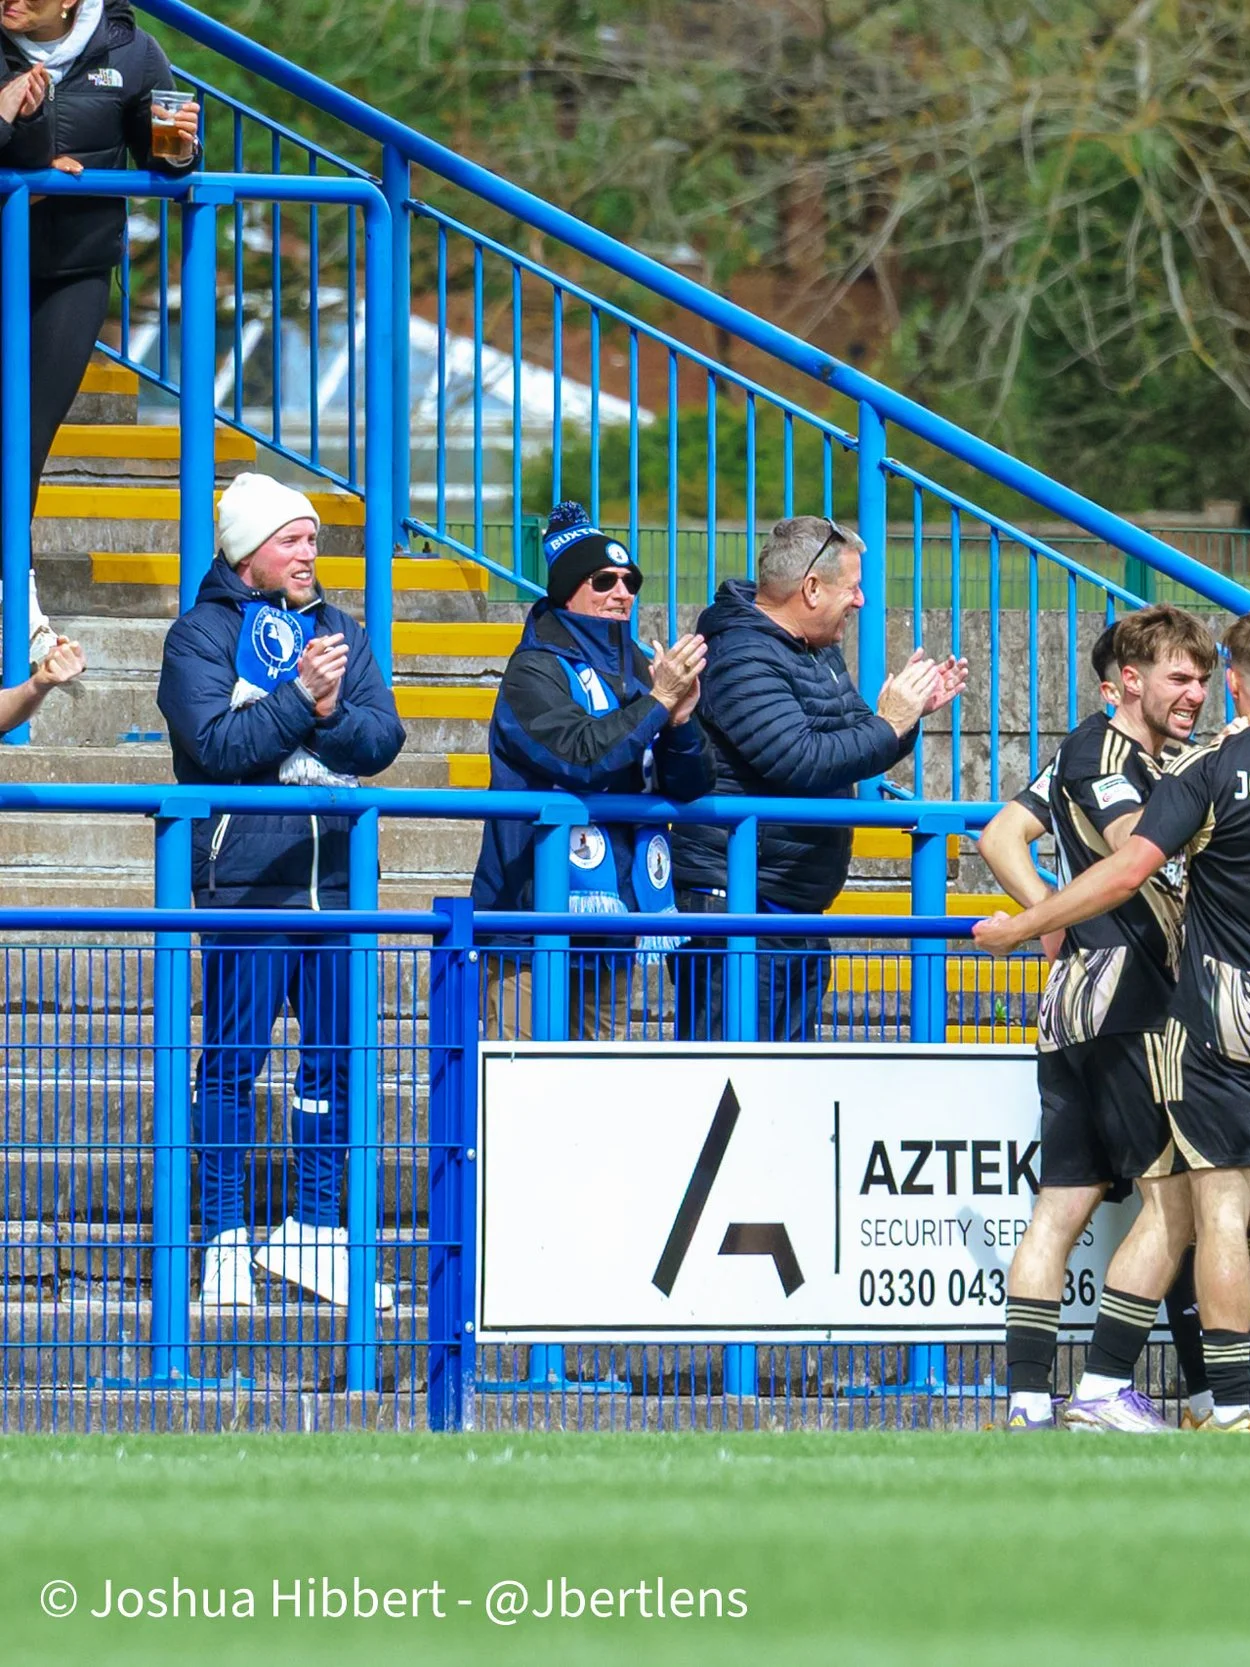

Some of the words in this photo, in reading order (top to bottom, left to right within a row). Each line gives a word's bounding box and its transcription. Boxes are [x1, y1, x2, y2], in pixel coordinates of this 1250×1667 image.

[859, 1140, 1042, 1195] AZTEK
[860, 1219, 973, 1247] SECURITY
[859, 1269, 935, 1307] 0330
[948, 1269, 1007, 1307] 043
